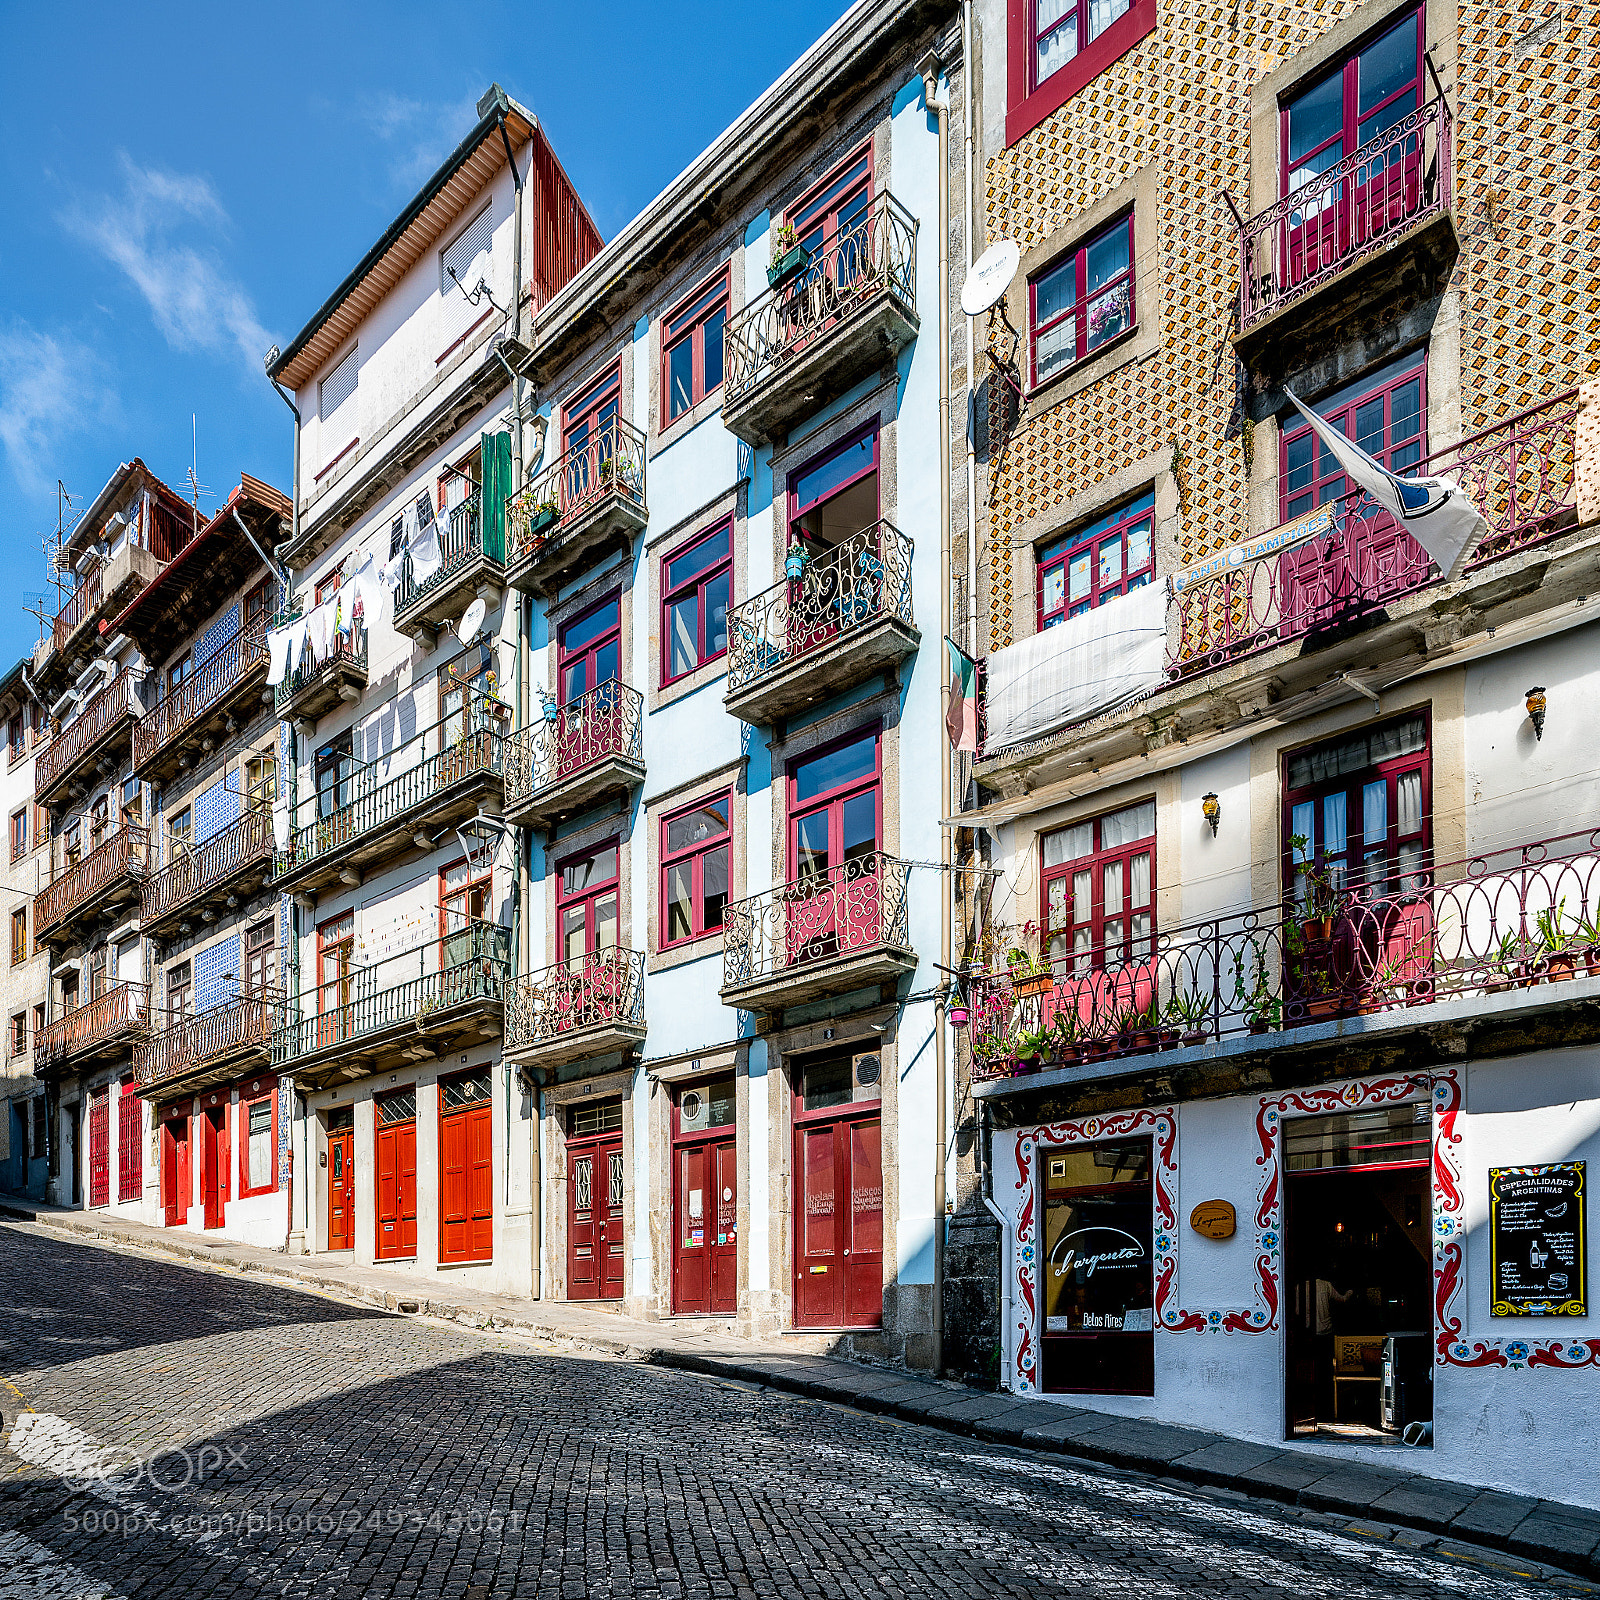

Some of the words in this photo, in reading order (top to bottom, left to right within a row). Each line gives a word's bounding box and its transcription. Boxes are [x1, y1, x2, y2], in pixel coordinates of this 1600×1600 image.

[1189, 557, 1226, 582] ANTI
[1246, 513, 1328, 558] LAMPIÕES
[1344, 1083, 1360, 1104] 4
[1086, 1118, 1097, 1137] 6
[1500, 1178, 1574, 1192] ESPECIALIDADES
[1073, 1247, 1140, 1278] argento
[1104, 1313, 1123, 1328] Aires
